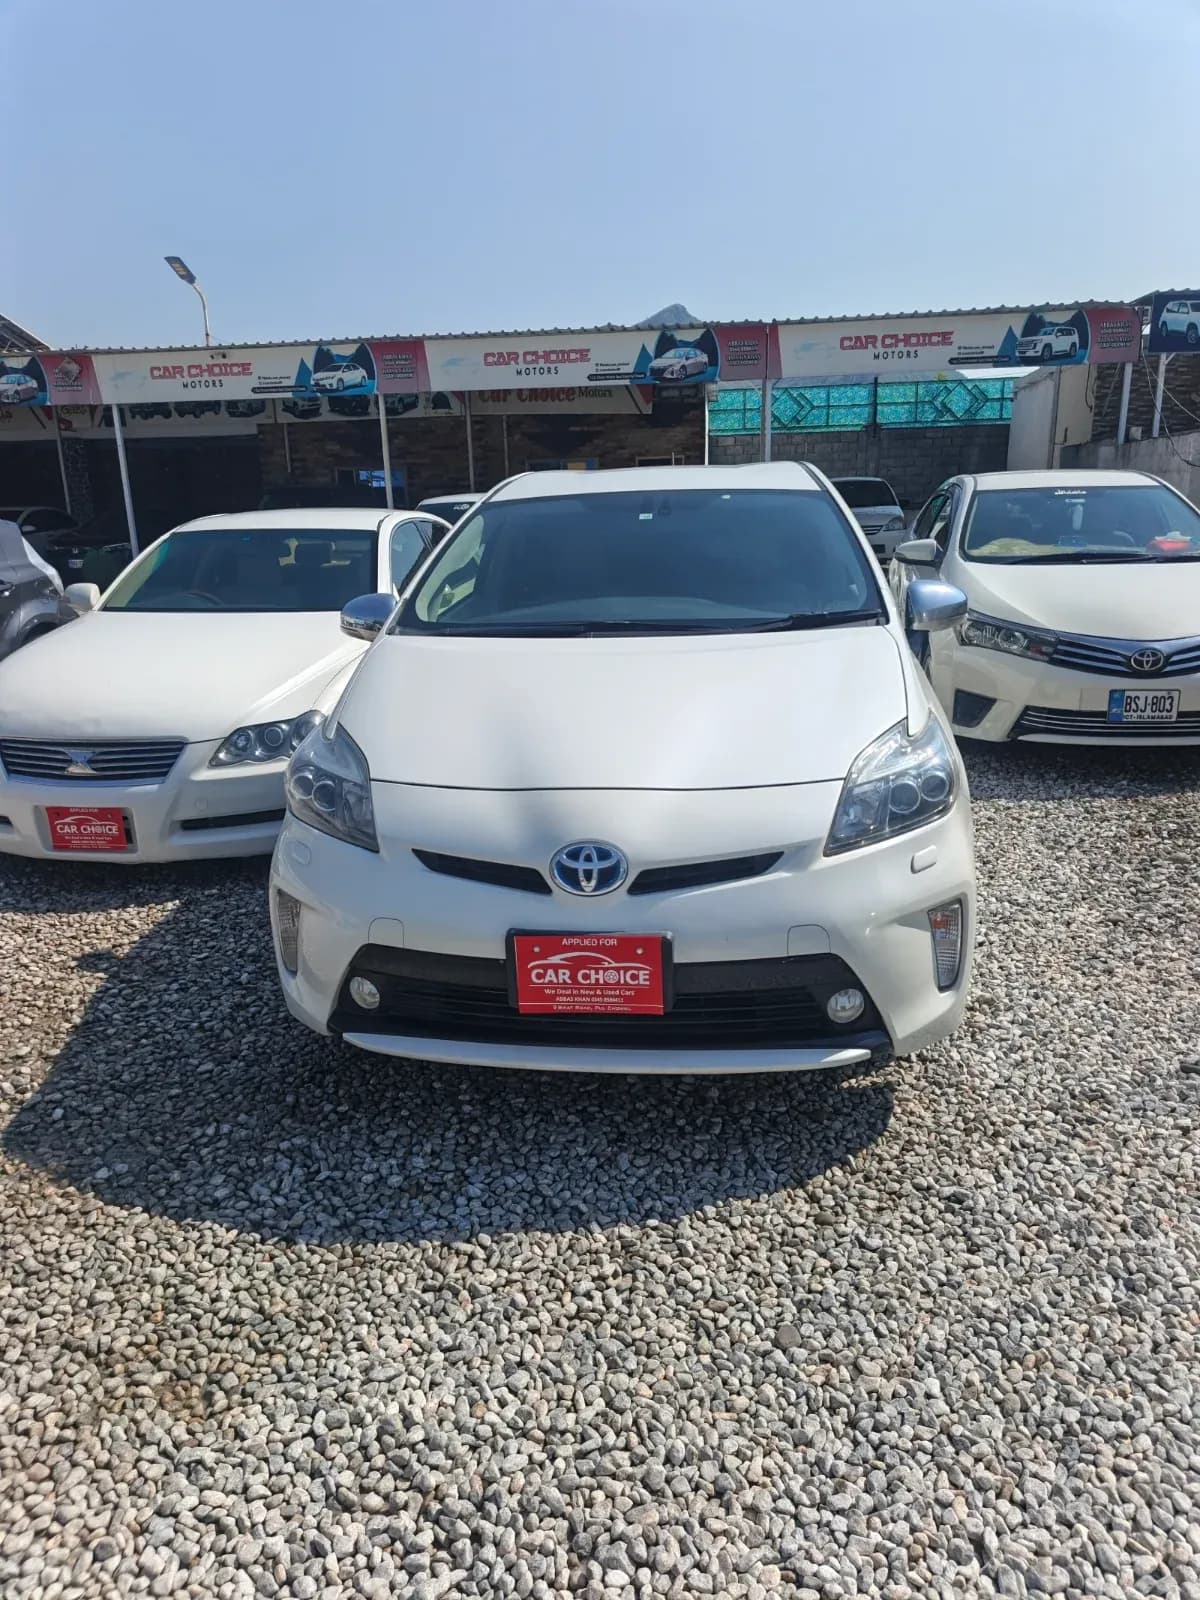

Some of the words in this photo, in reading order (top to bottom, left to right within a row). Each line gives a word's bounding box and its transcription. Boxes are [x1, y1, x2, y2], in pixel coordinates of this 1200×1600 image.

[840, 335, 878, 350] CAR
[881, 331, 954, 348] CHOICE
[484, 352, 519, 366] CAR
[523, 349, 591, 365] CHOICE
[873, 350, 919, 360] MOTORS
[150, 365, 184, 380] CAR
[187, 363, 253, 378] CHOICE
[516, 366, 559, 376] MOTORS
[182, 379, 223, 389] MOTORS
[517, 387, 577, 403] Choice
[56, 825, 79, 834] CAR
[80, 825, 119, 834] CHOICE
[561, 937, 599, 947] APPLIED
[599, 938, 618, 947] FOR
[531, 969, 572, 985] CAR
[577, 969, 651, 986] CHOICE
